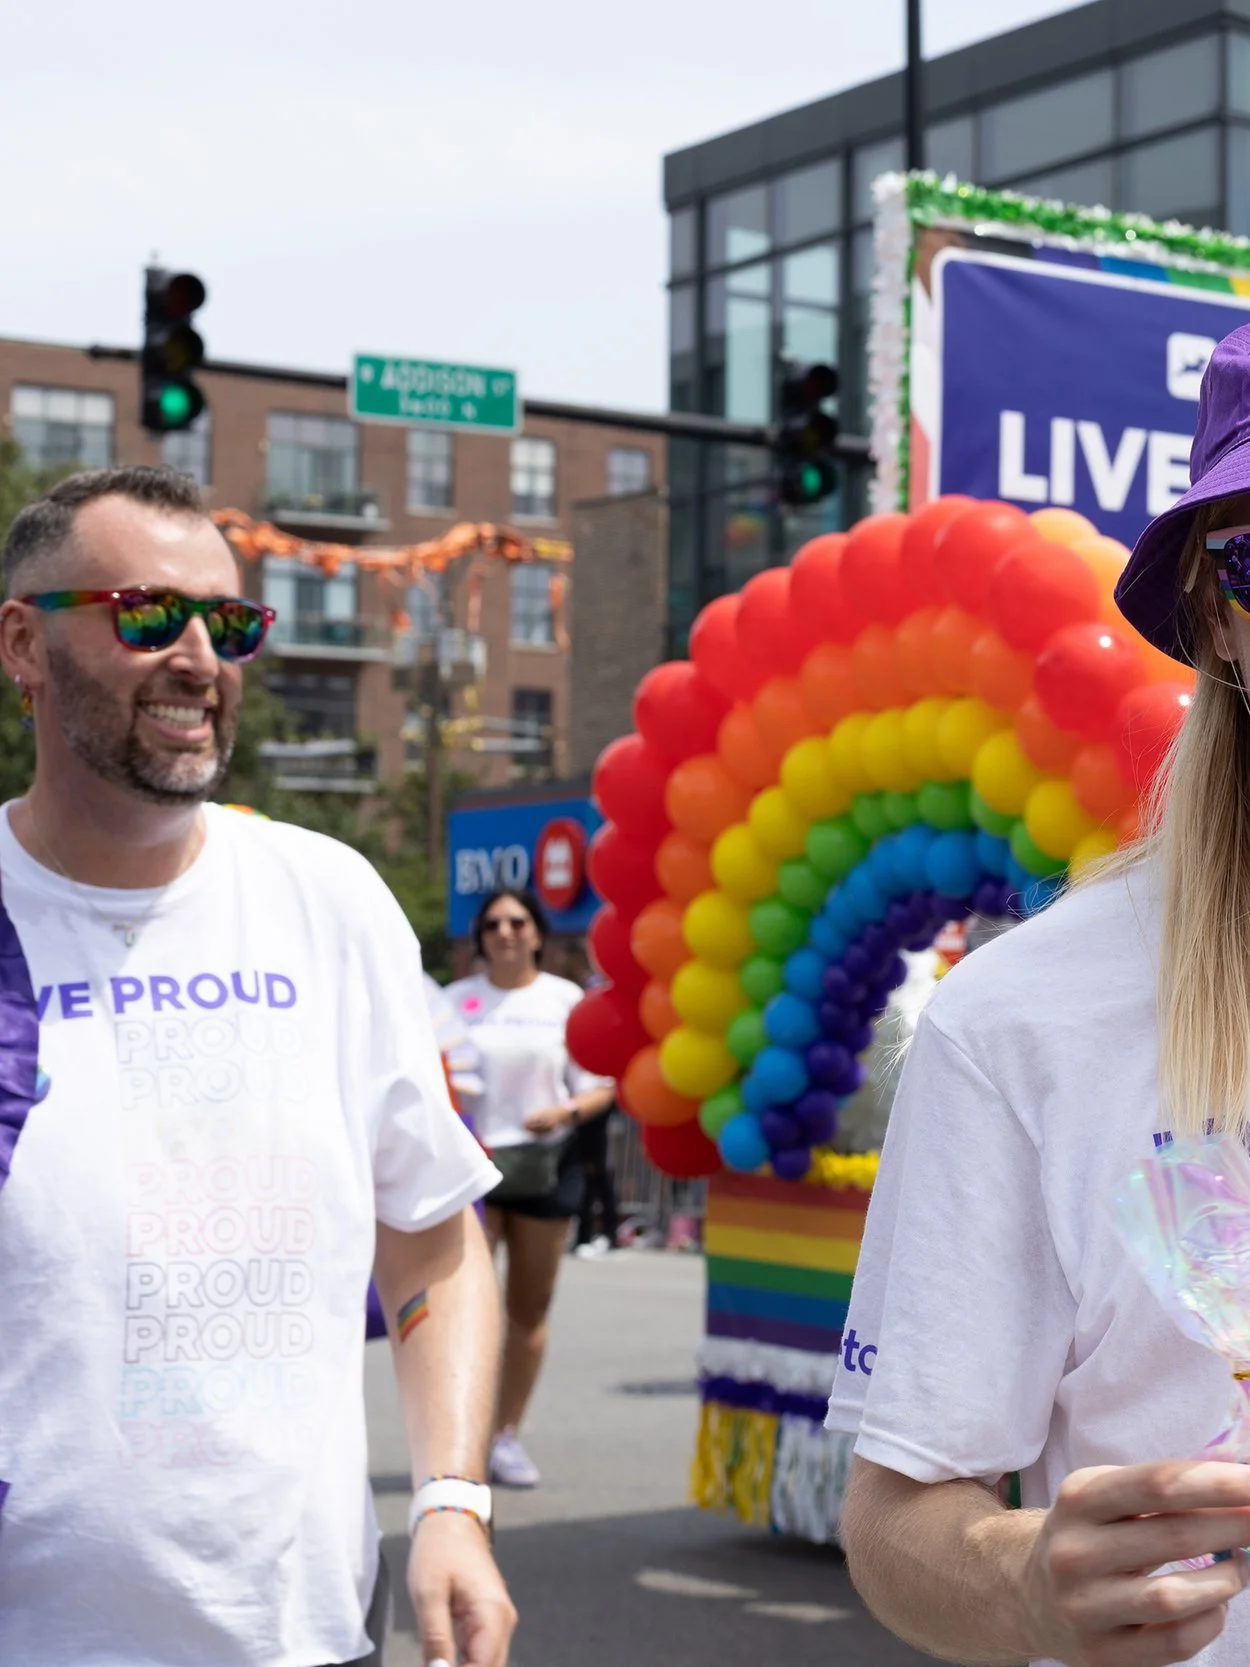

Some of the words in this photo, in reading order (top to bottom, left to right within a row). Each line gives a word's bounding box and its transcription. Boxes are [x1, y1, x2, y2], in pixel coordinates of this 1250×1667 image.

[999, 410, 1192, 517] LIVE
[110, 969, 298, 1015] PROUD
[126, 1206, 317, 1258] PROUD
[125, 1258, 315, 1311] PROUD
[123, 1311, 316, 1364] PROUD
